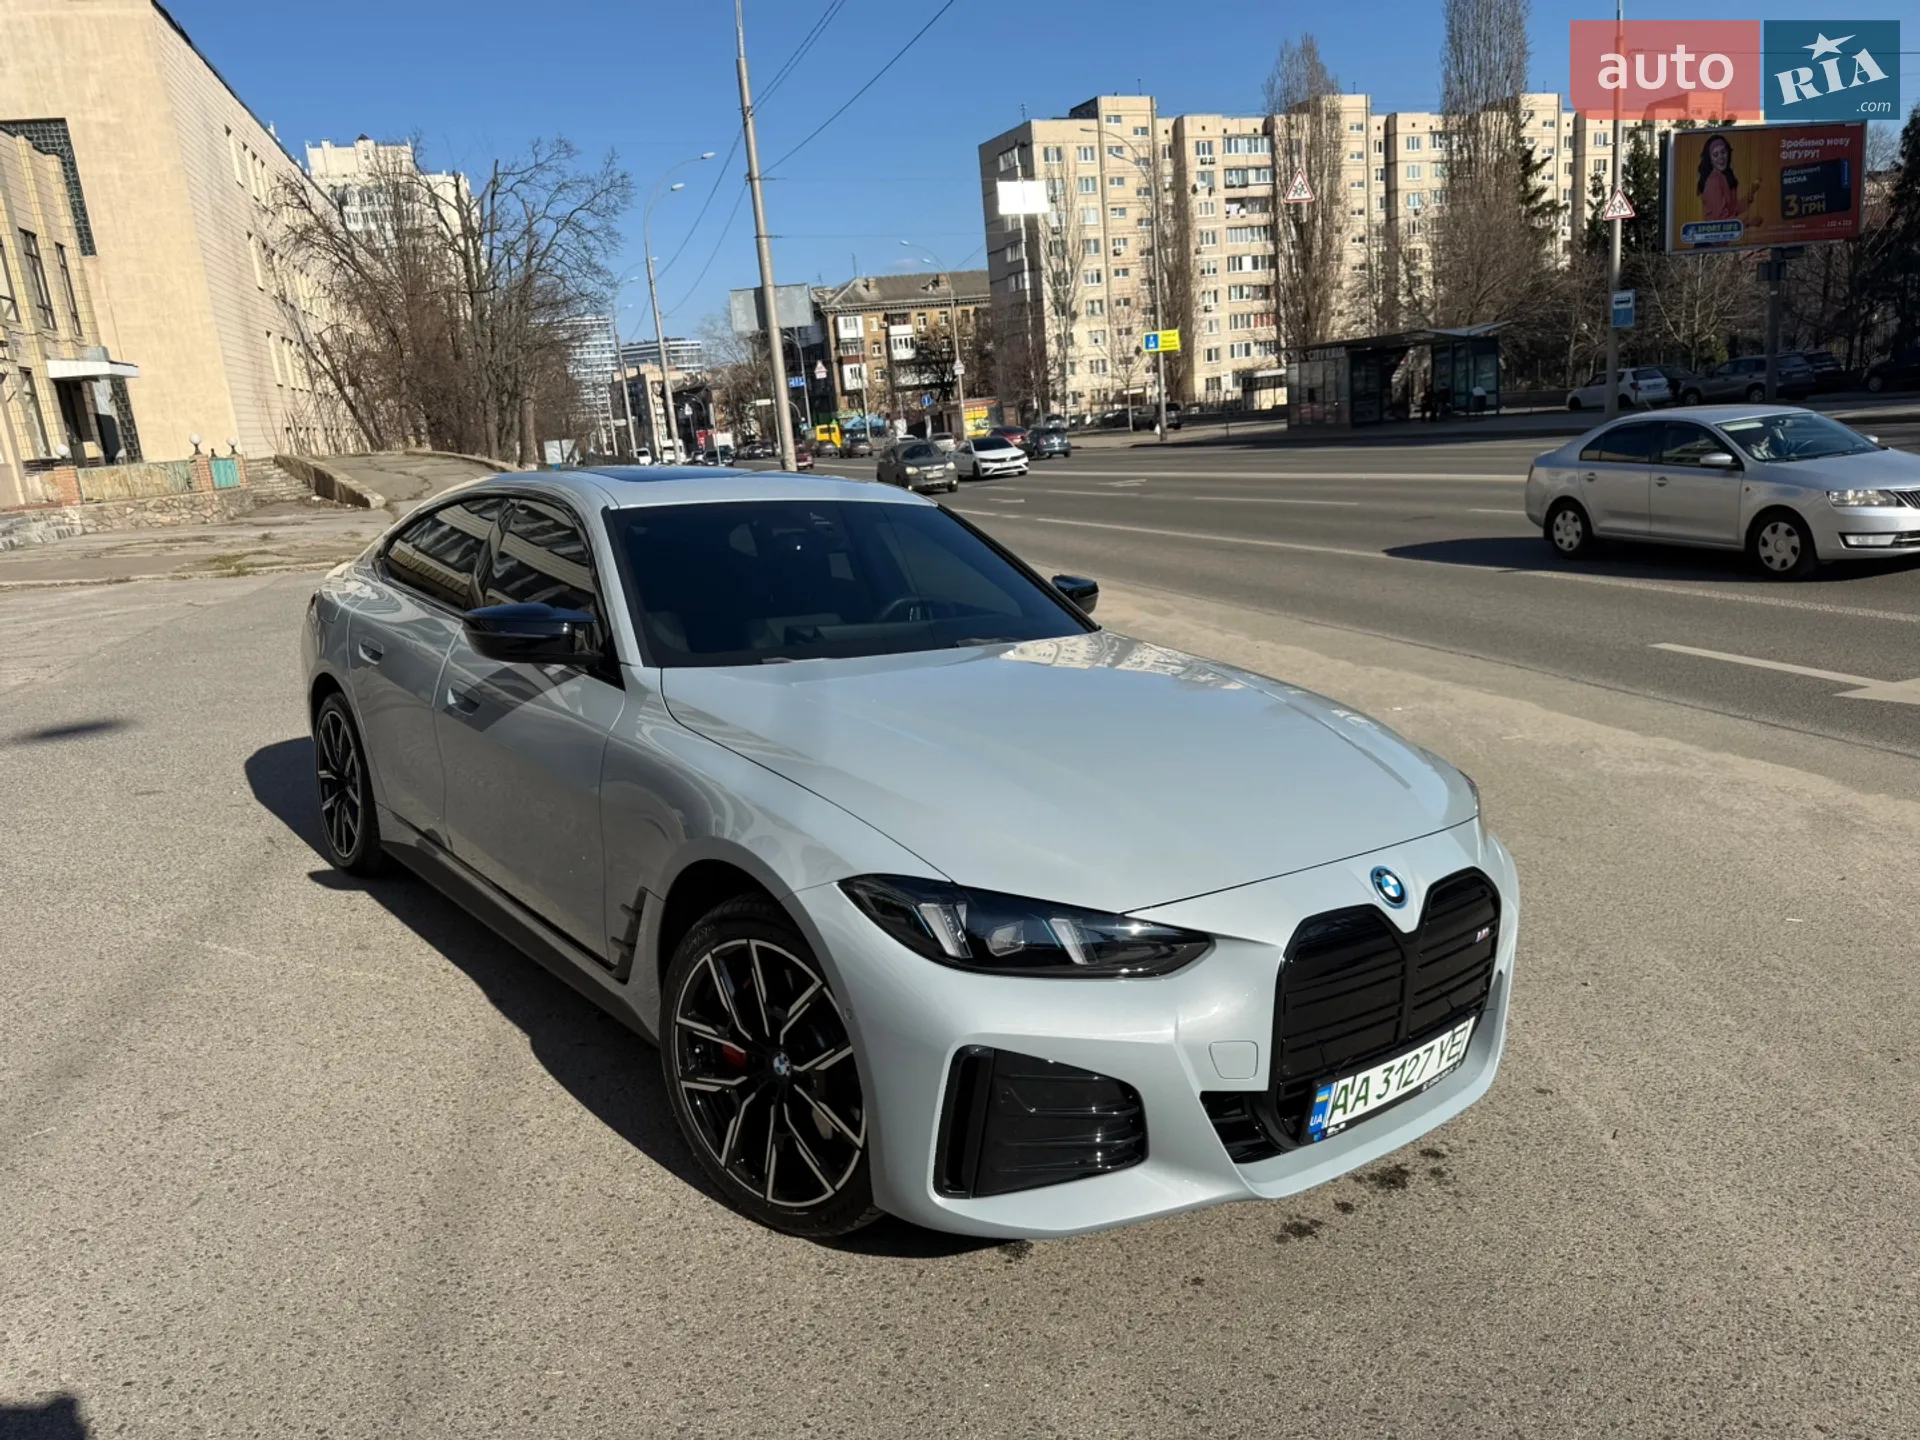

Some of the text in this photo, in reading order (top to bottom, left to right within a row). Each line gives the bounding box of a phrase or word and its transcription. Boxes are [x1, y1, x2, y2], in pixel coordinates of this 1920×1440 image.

[1780, 138, 1850, 149] Зробимо нову
[1784, 194, 1798, 216] 3
[1329, 1076, 1370, 1119] AA
[1376, 1046, 1434, 1099] 3127
[1310, 1115, 1323, 1127] UA
